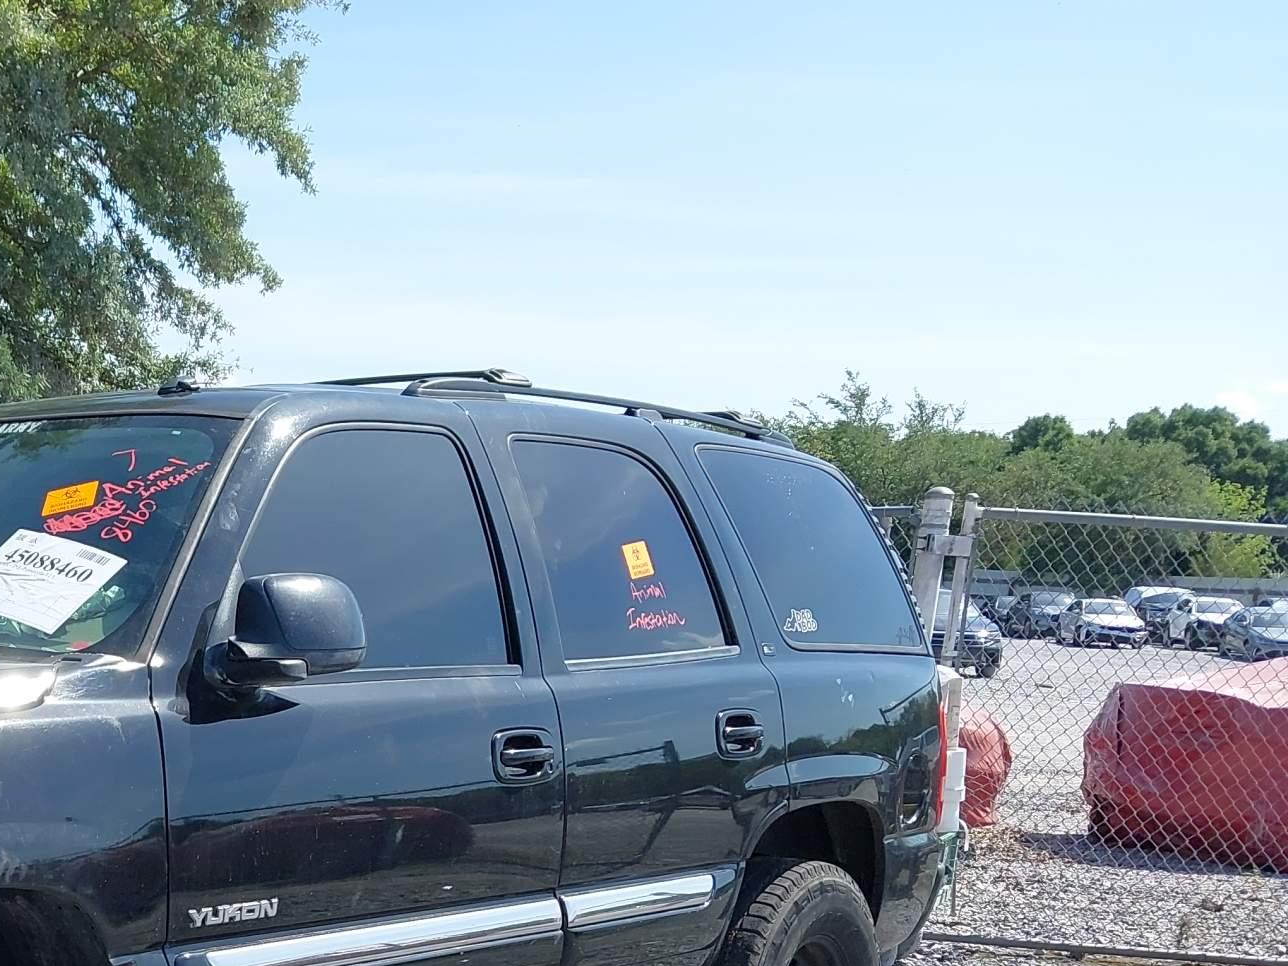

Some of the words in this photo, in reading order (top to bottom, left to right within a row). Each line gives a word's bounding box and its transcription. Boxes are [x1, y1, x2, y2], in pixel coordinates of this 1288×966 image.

[101, 499, 156, 543] 8460
[4, 549, 93, 582] 45088460
[630, 581, 666, 604] Animal
[626, 607, 685, 630] Infestation
[188, 897, 279, 928] YUKON
